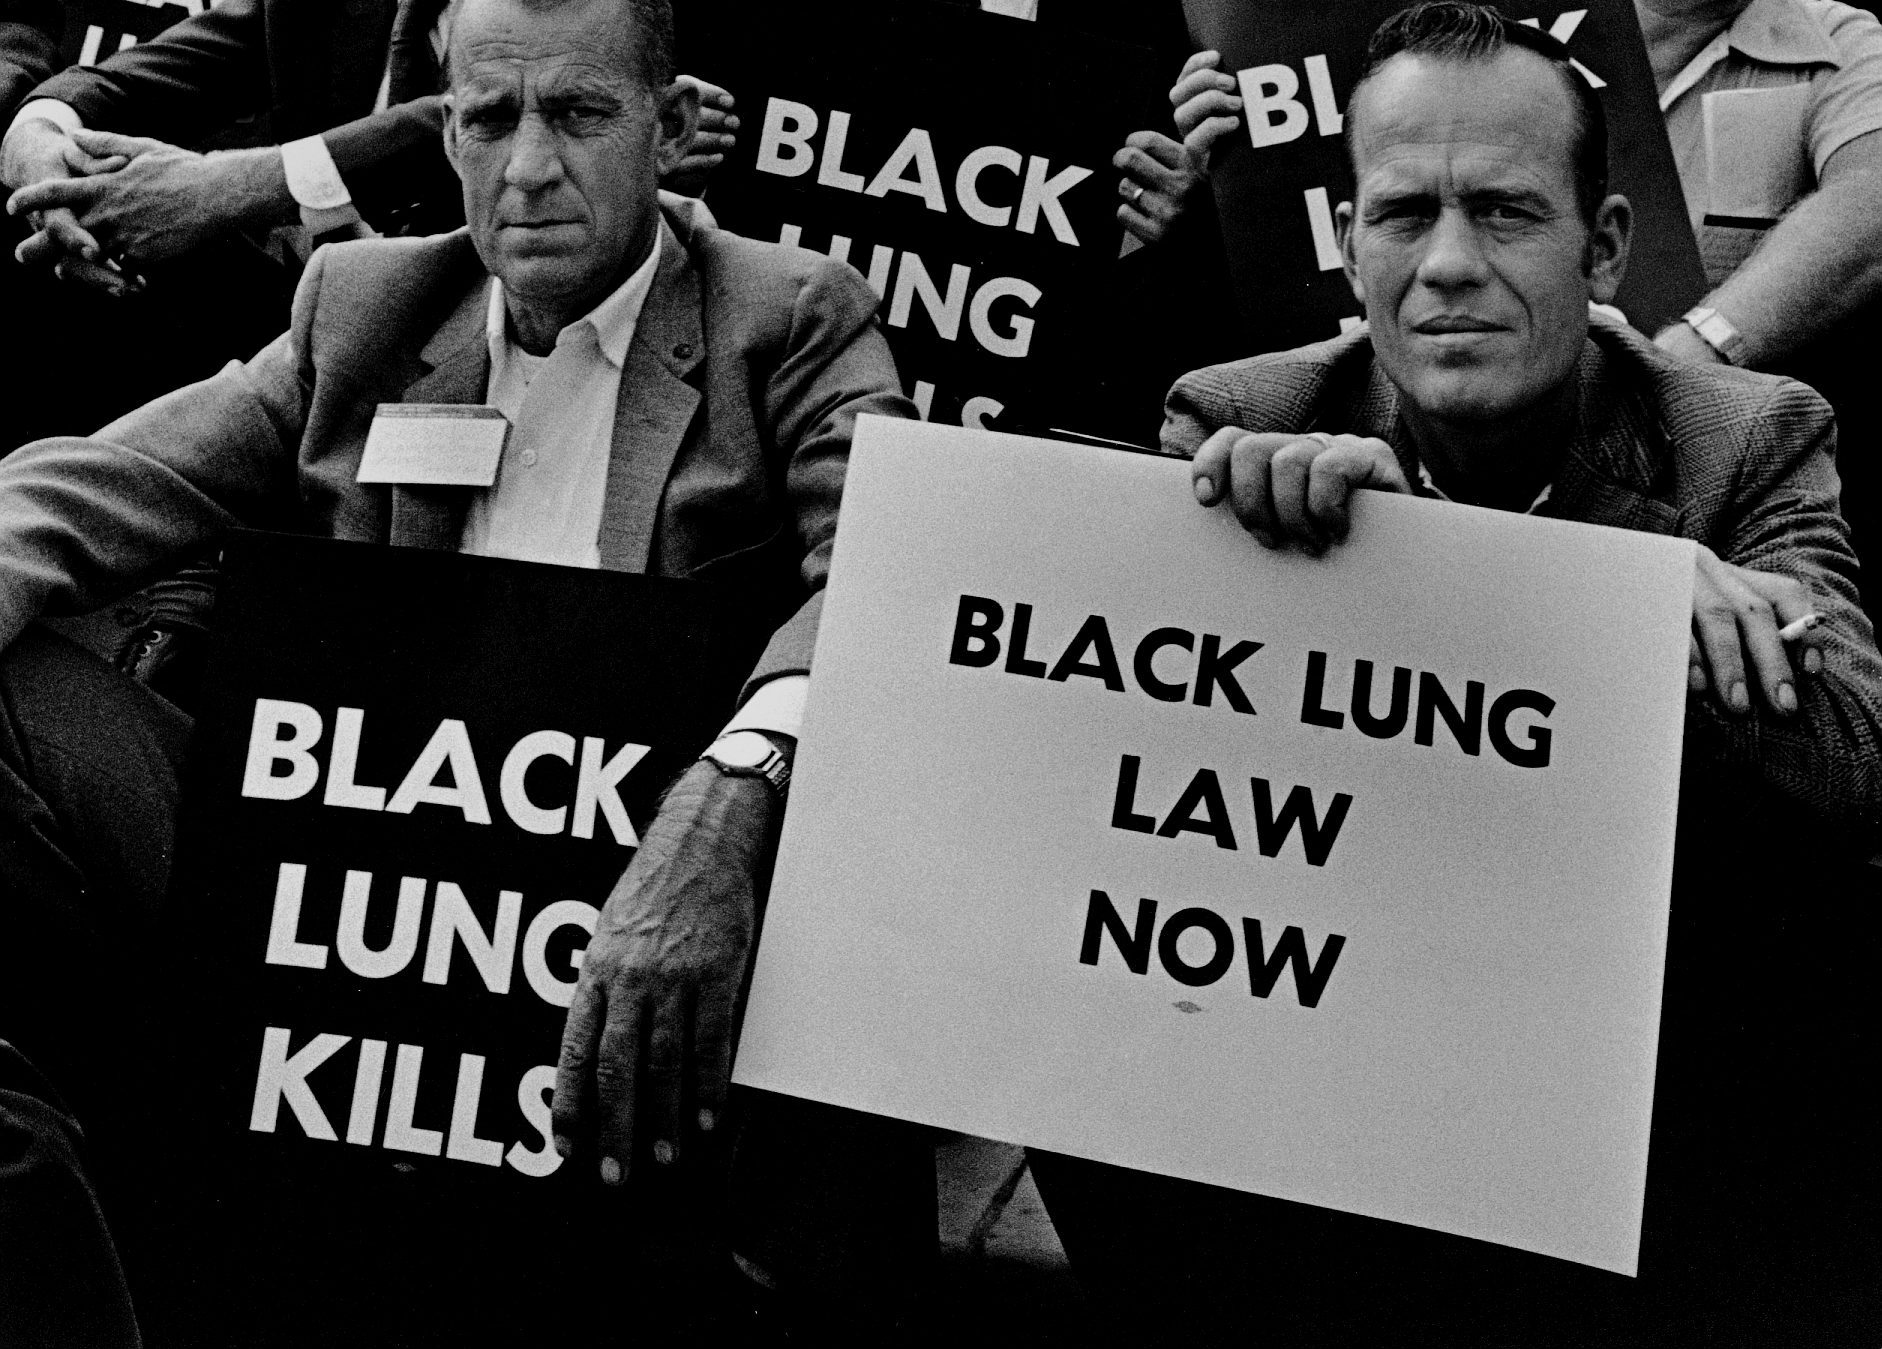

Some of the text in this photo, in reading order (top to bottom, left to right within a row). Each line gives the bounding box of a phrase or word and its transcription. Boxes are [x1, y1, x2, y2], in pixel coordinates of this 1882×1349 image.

[756, 95, 1095, 248] BLACK
[949, 593, 1557, 769] BLACK LUNG
[241, 698, 652, 849] BLACK
[1110, 753, 1354, 867] LAW
[265, 862, 603, 1009] LUNG
[1079, 889, 1347, 1009] NOW
[248, 1026, 567, 1178] KILLS
